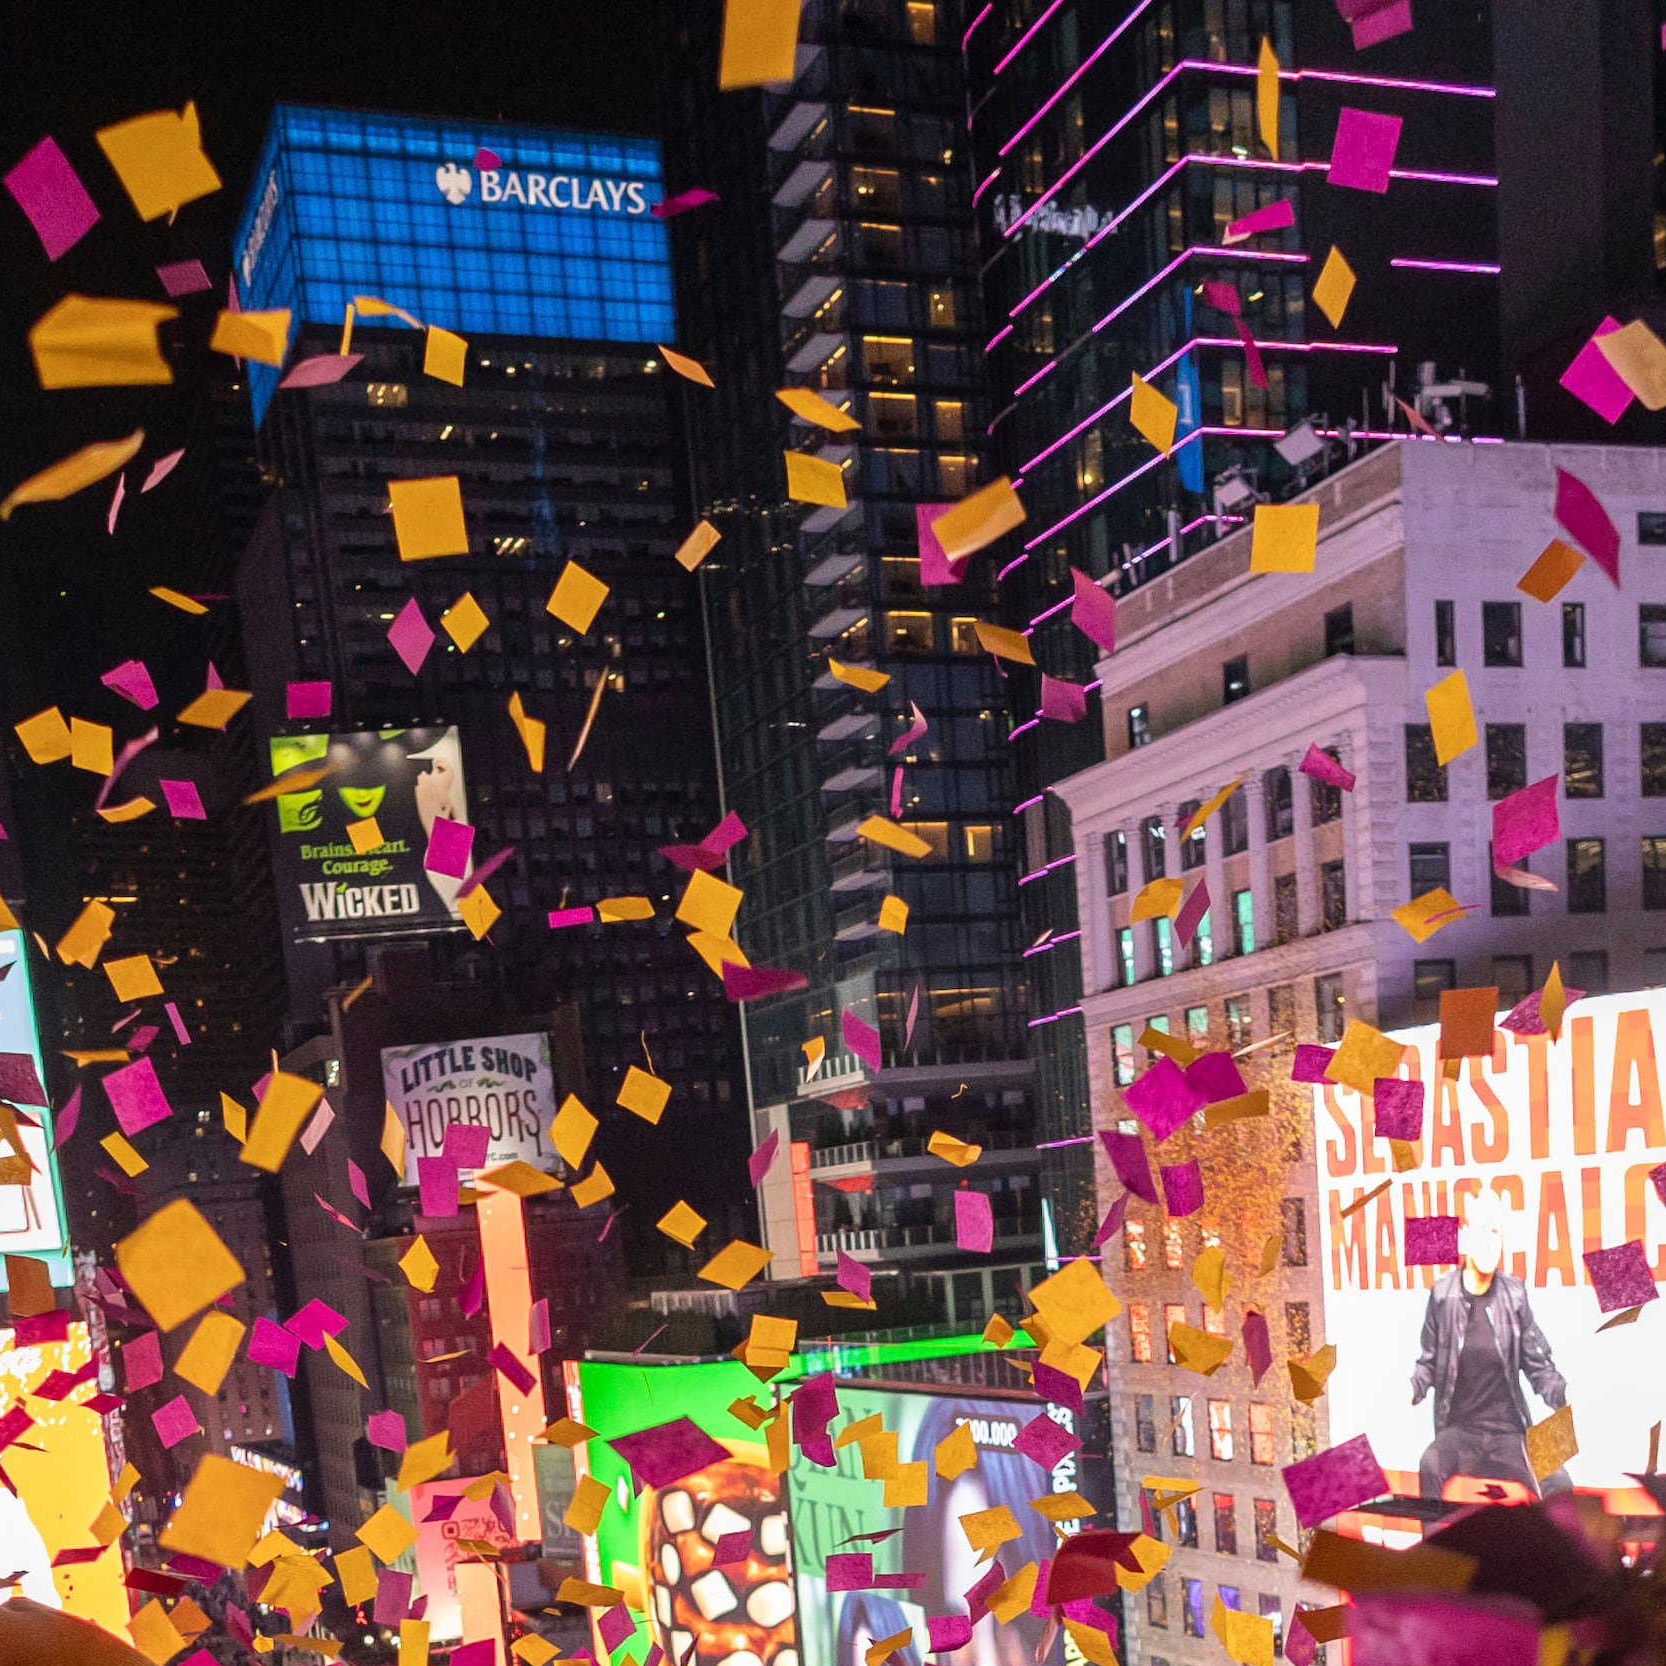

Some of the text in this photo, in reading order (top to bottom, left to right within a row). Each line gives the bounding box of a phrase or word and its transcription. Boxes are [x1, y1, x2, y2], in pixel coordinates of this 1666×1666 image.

[480, 169, 646, 216] BARCLAYS
[321, 858, 394, 877] Courage.
[400, 1045, 538, 1095] LITTLE SHOP
[458, 1078, 474, 1088] OF
[405, 1089, 543, 1157] HORRORS
